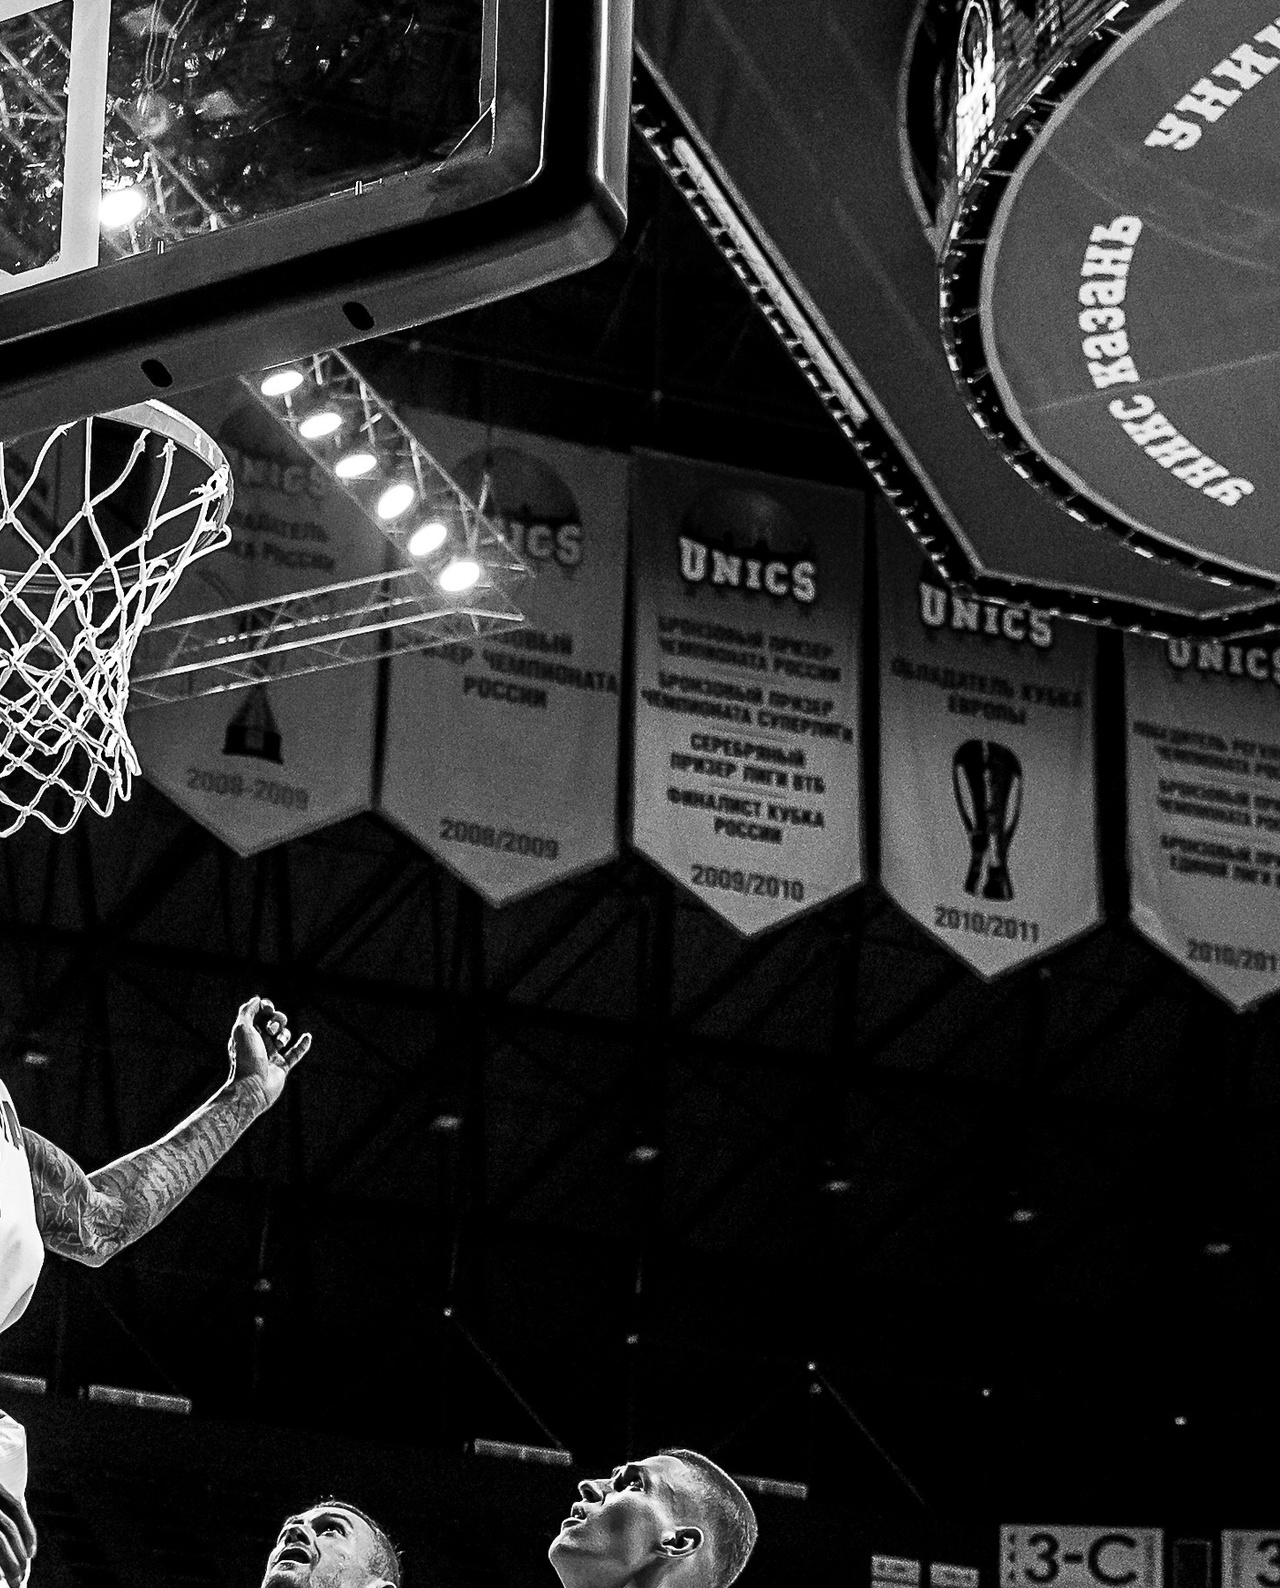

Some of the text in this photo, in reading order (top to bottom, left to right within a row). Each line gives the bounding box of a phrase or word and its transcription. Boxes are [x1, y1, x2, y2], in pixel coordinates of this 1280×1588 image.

[678, 536, 818, 604] UNICS
[918, 582, 1053, 648] UNICS
[463, 675, 548, 709] РОССИИ
[666, 786, 825, 828] ФИНАЛИСТ КУБКА
[439, 817, 560, 861] 2008/2009
[714, 816, 782, 844] РОССИИ
[691, 864, 804, 902] 2009/2010
[934, 905, 1040, 943] 2010/2011
